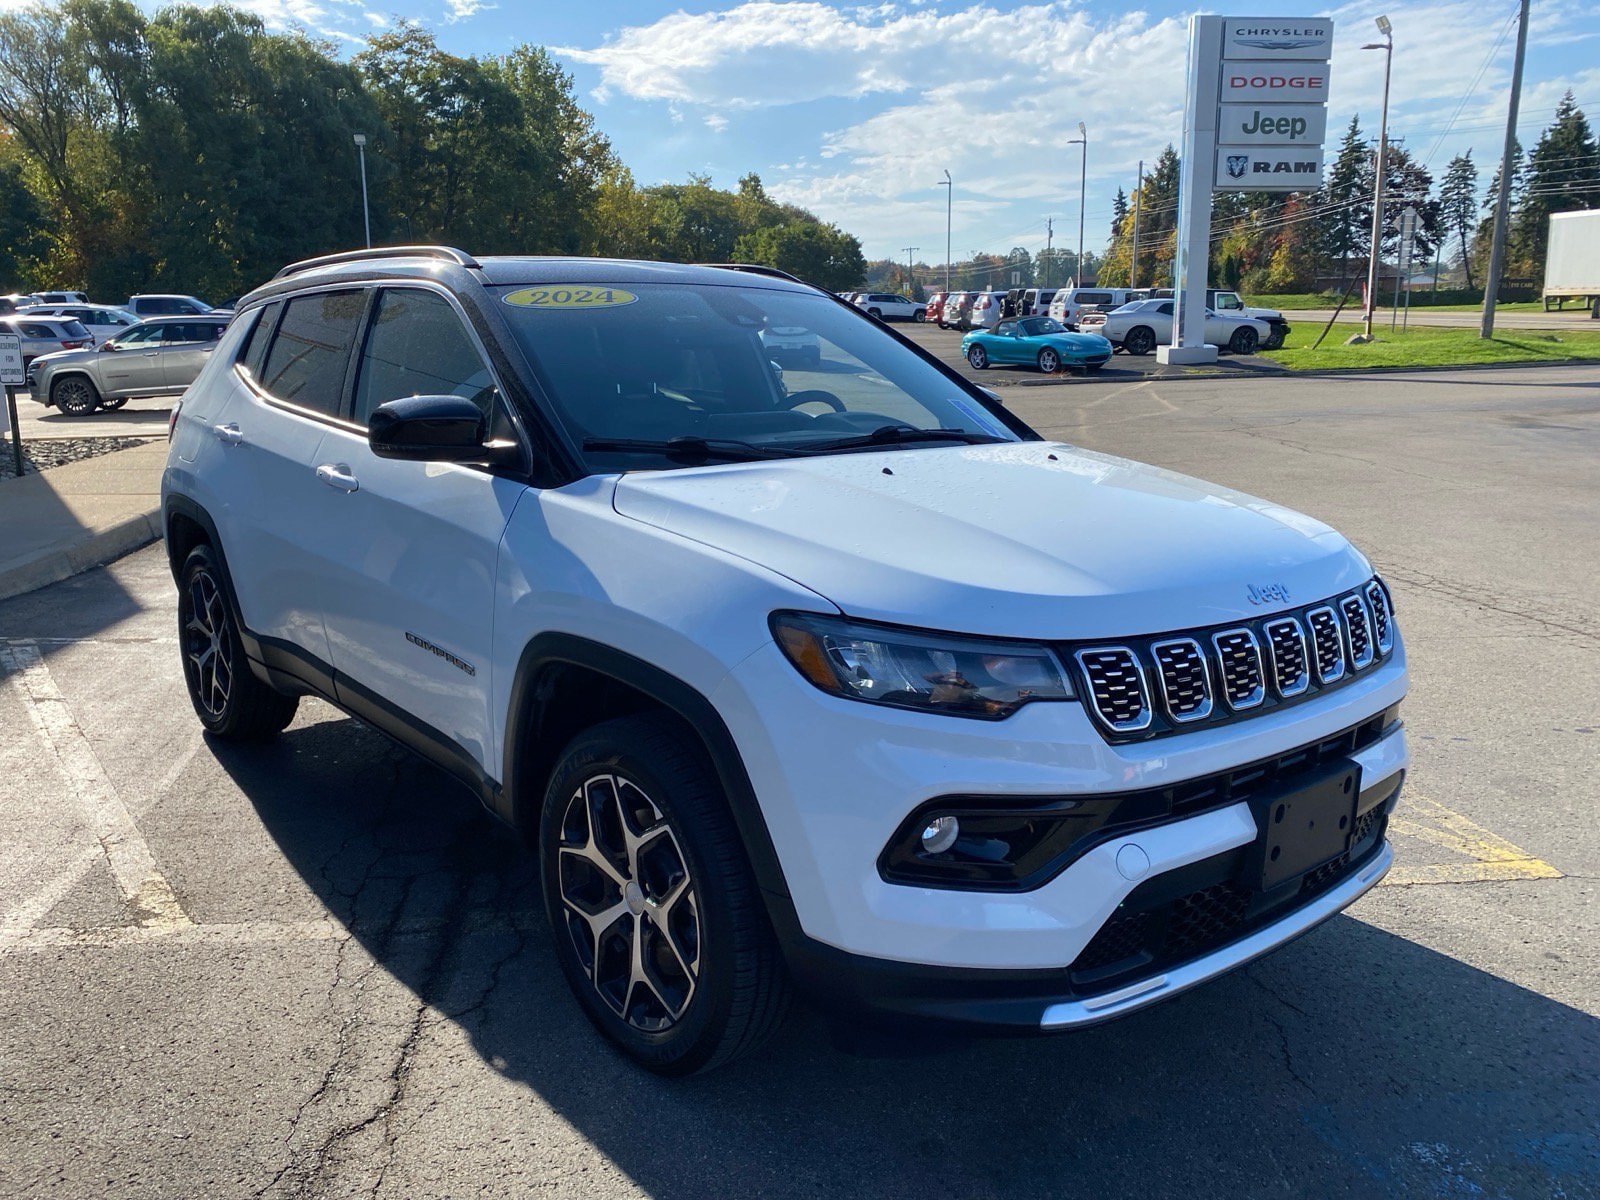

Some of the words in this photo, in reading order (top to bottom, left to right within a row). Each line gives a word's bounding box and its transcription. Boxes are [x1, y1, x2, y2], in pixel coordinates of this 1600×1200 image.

[1235, 28, 1325, 36] CHRYSLER
[1230, 77, 1323, 88] DODGE
[1242, 110, 1307, 140] Jeep
[1252, 161, 1317, 174] RAM
[530, 290, 617, 305] 2024
[1246, 583, 1290, 606] Jeep
[404, 630, 476, 677] COMPASS
